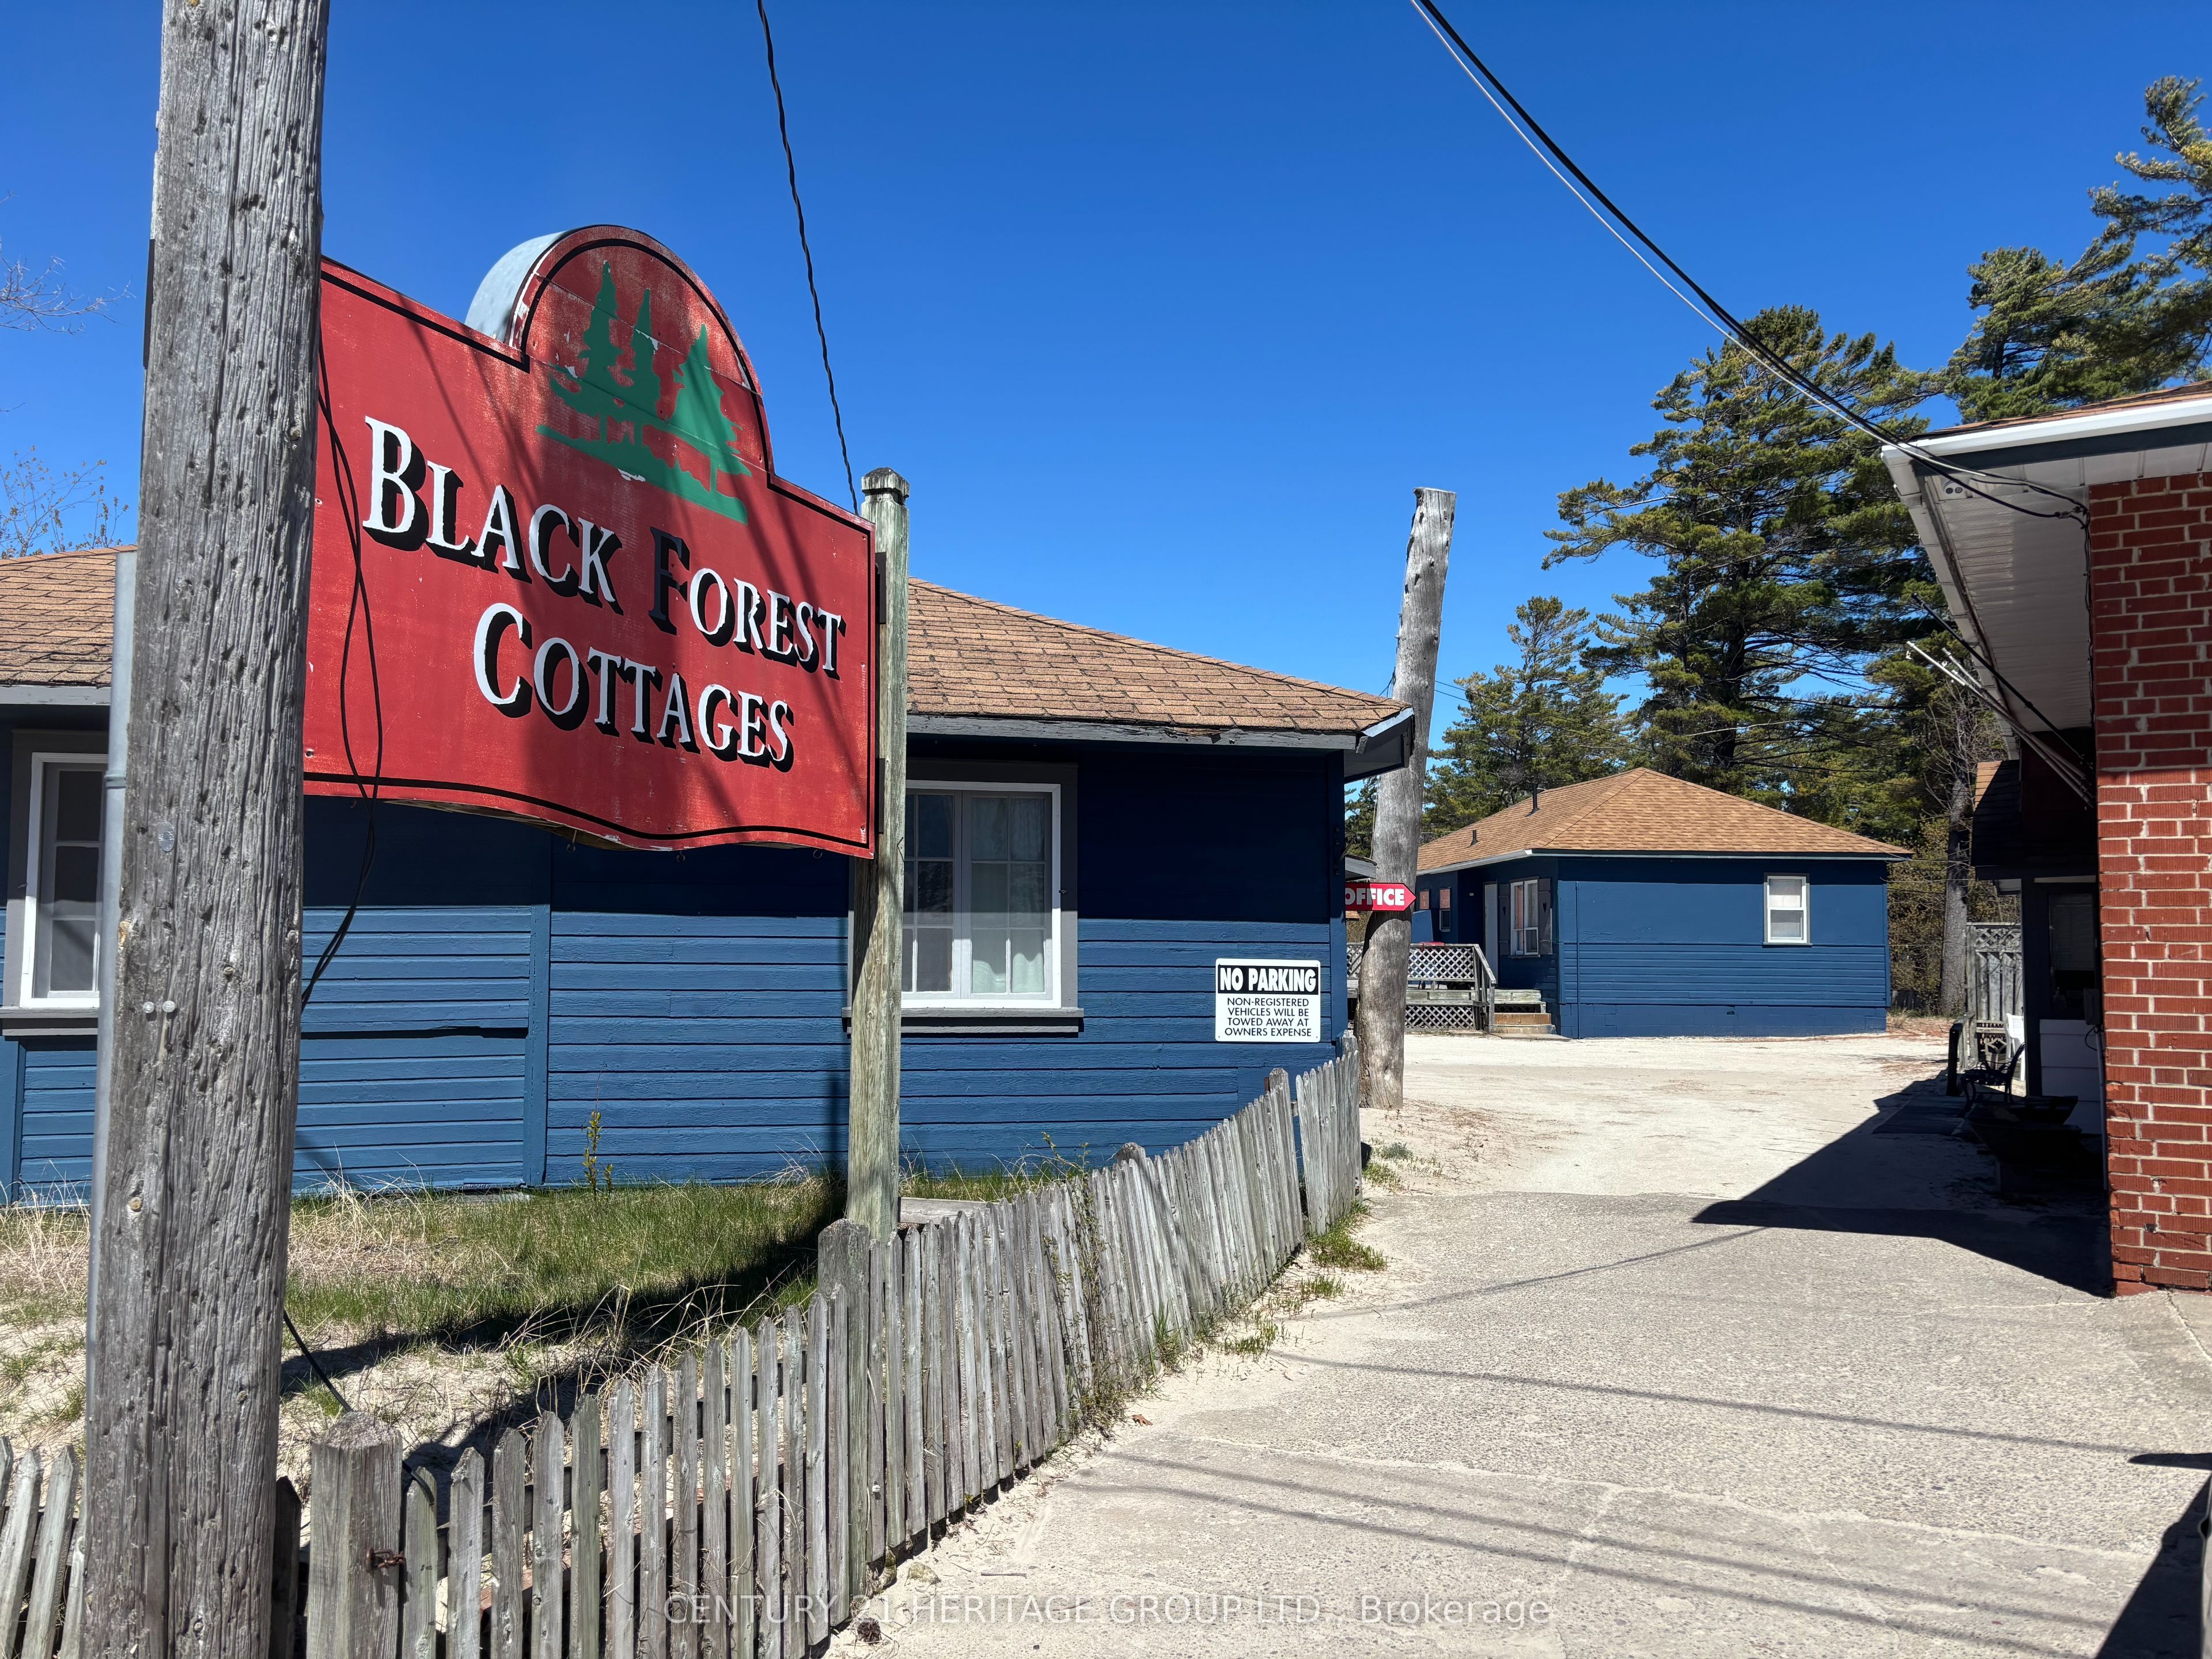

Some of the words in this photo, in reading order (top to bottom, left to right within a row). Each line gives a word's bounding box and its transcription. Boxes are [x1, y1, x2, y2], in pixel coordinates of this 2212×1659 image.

[363, 416, 622, 614] BLACK
[649, 527, 845, 679] FOREST
[474, 603, 794, 771] COTTAGES
[1345, 888, 1405, 906] OFFICE
[1220, 967, 1243, 991] NO
[1248, 968, 1316, 992] PARKING
[1227, 997, 1309, 1006] NON-REGISTERED
[1228, 1007, 1271, 1016] VEHICLES
[1274, 1008, 1295, 1017] WILL
[1298, 1009, 1309, 1017] BE
[1228, 1017, 1263, 1026] TOWED
[1266, 1018, 1294, 1027] AWAY
[1297, 1018, 1309, 1027] AT
[1225, 1028, 1268, 1036] OWNERS
[1271, 1028, 1312, 1037] EXPENSE
